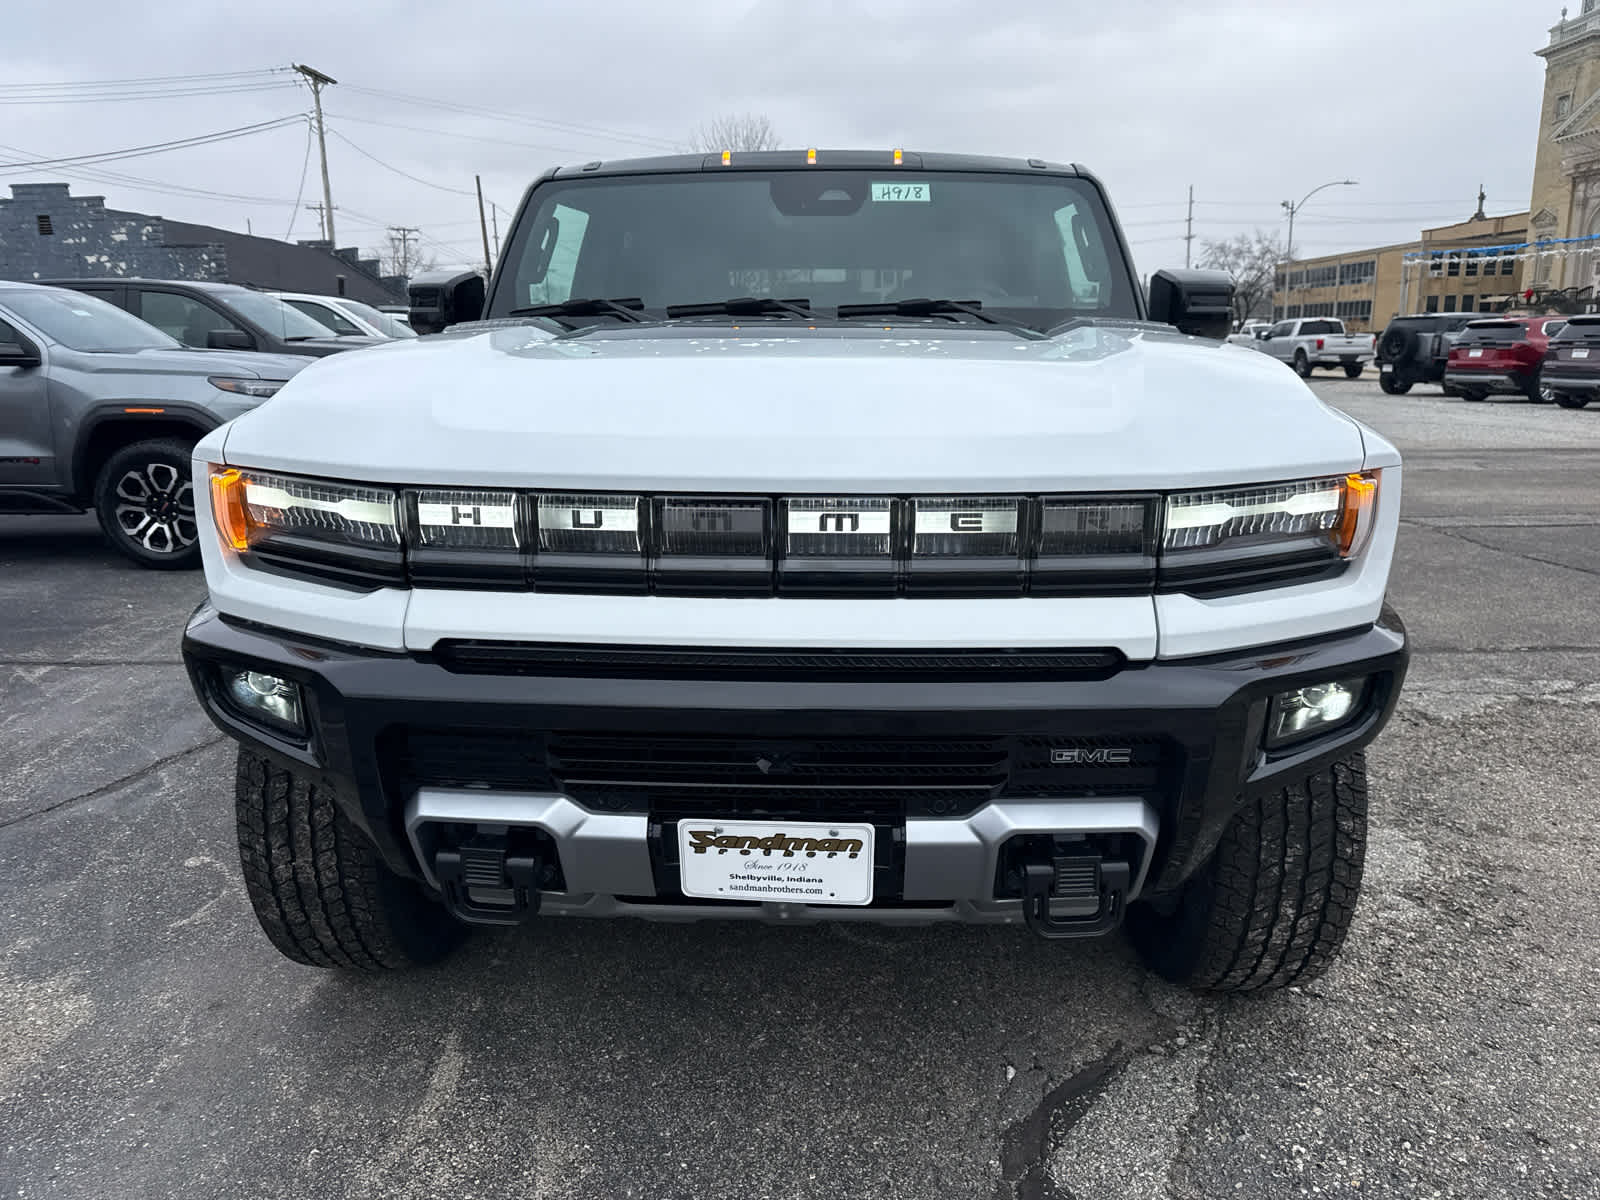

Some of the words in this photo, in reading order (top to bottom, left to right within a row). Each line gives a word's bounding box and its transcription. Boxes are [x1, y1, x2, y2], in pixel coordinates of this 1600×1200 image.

[881, 184, 923, 200] H918
[1050, 748, 1131, 763] GMC
[688, 830, 863, 853] Sandman
[744, 859, 773, 871] Since
[776, 861, 808, 872] 1918
[729, 873, 785, 883] Shelbyville,
[786, 876, 823, 884] Indiana
[729, 883, 823, 895] sandmanbrothers.com
